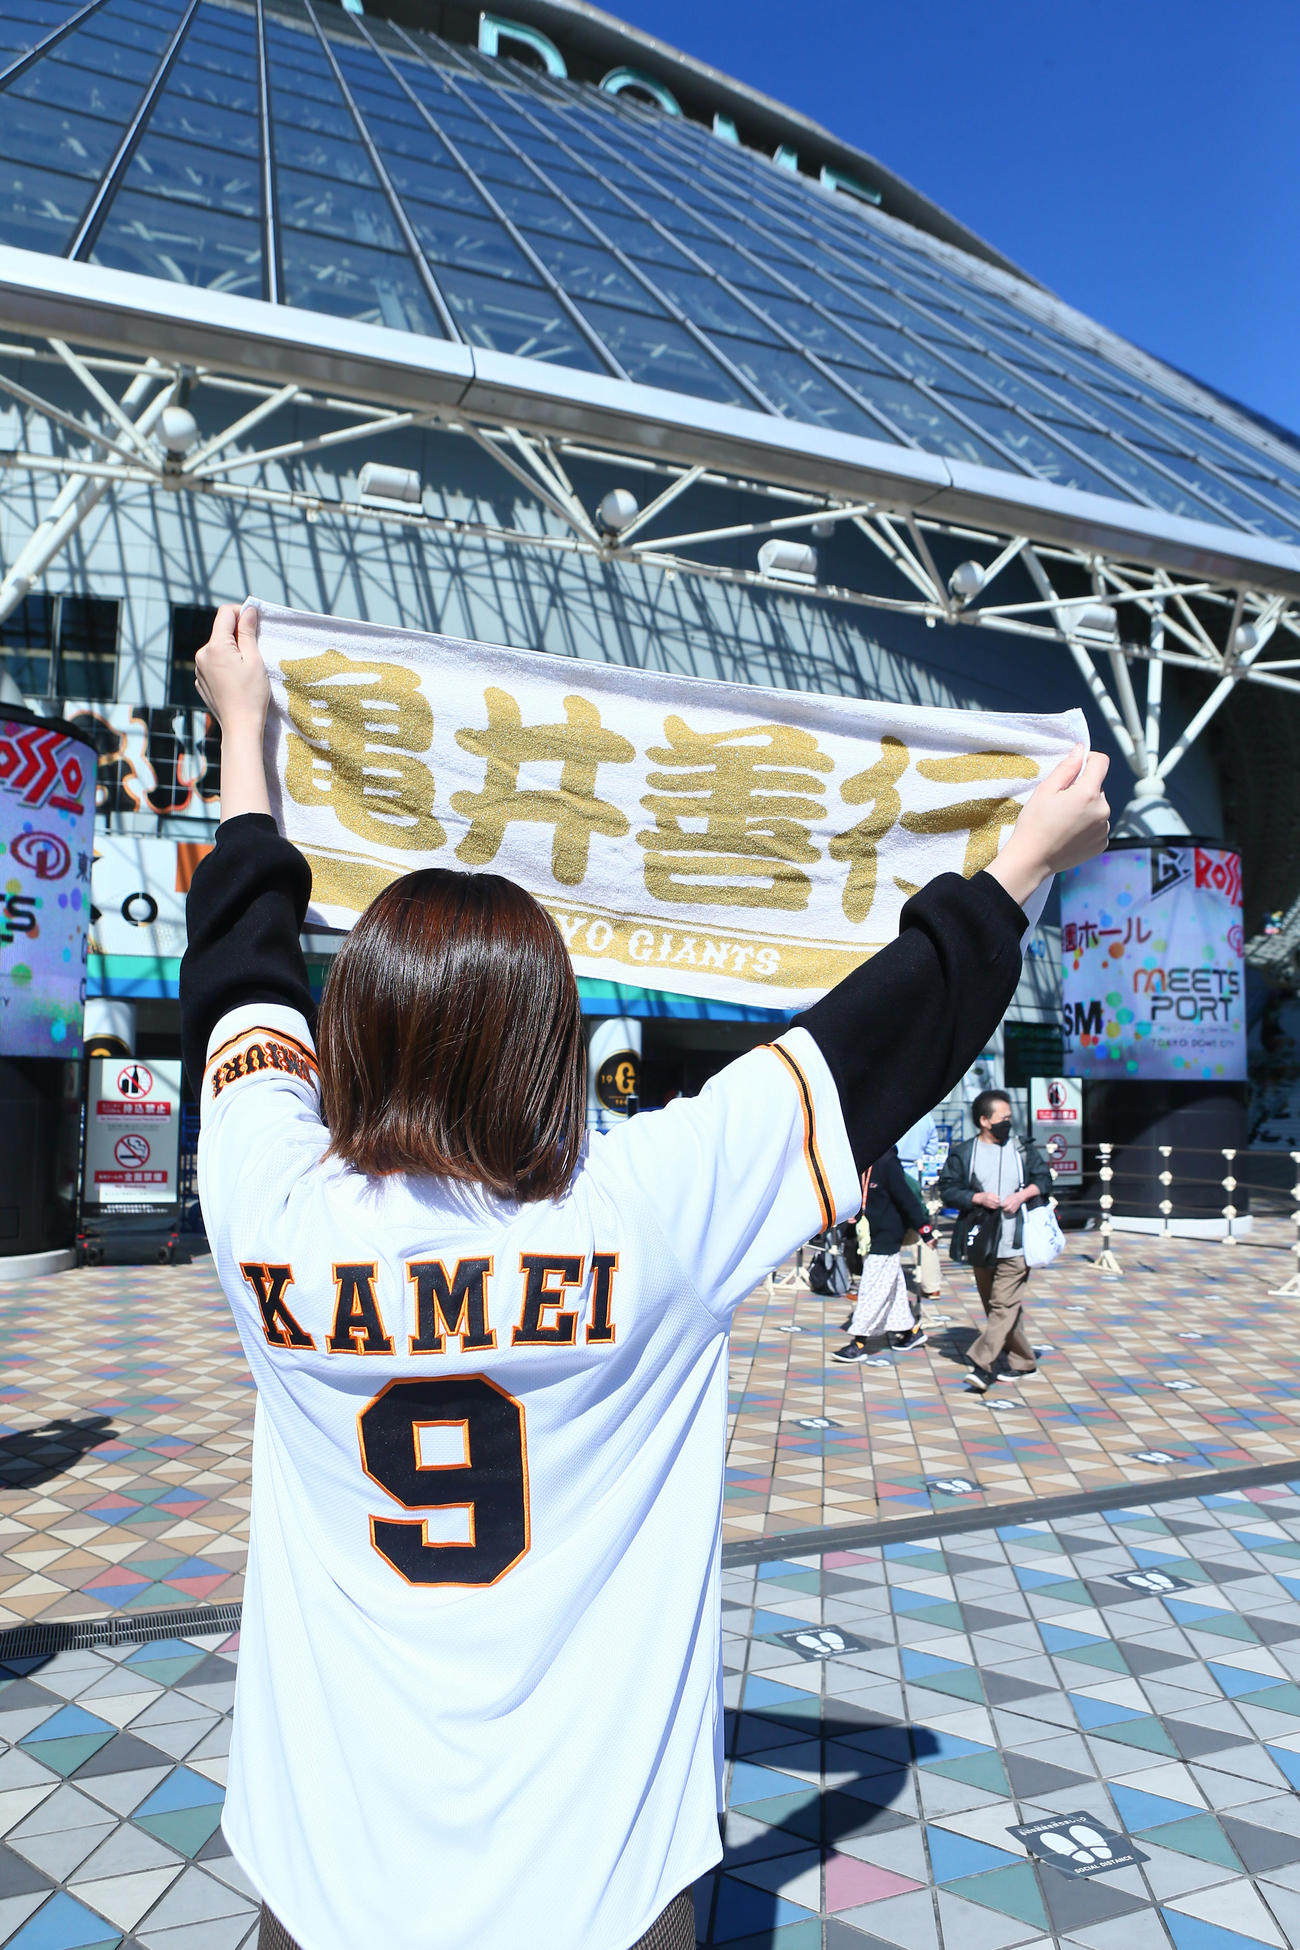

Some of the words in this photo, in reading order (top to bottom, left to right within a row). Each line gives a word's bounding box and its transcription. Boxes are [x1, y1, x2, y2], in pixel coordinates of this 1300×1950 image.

[627, 928, 782, 976] GIANTS
[1133, 968, 1240, 995] MEETS
[1151, 996, 1232, 1021] PORT
[238, 1251, 621, 1356] KAMEI
[356, 1373, 532, 1588] 9
[1073, 1864, 1101, 1874] SOCIAL
[1100, 1855, 1135, 1868] DISTANCE
